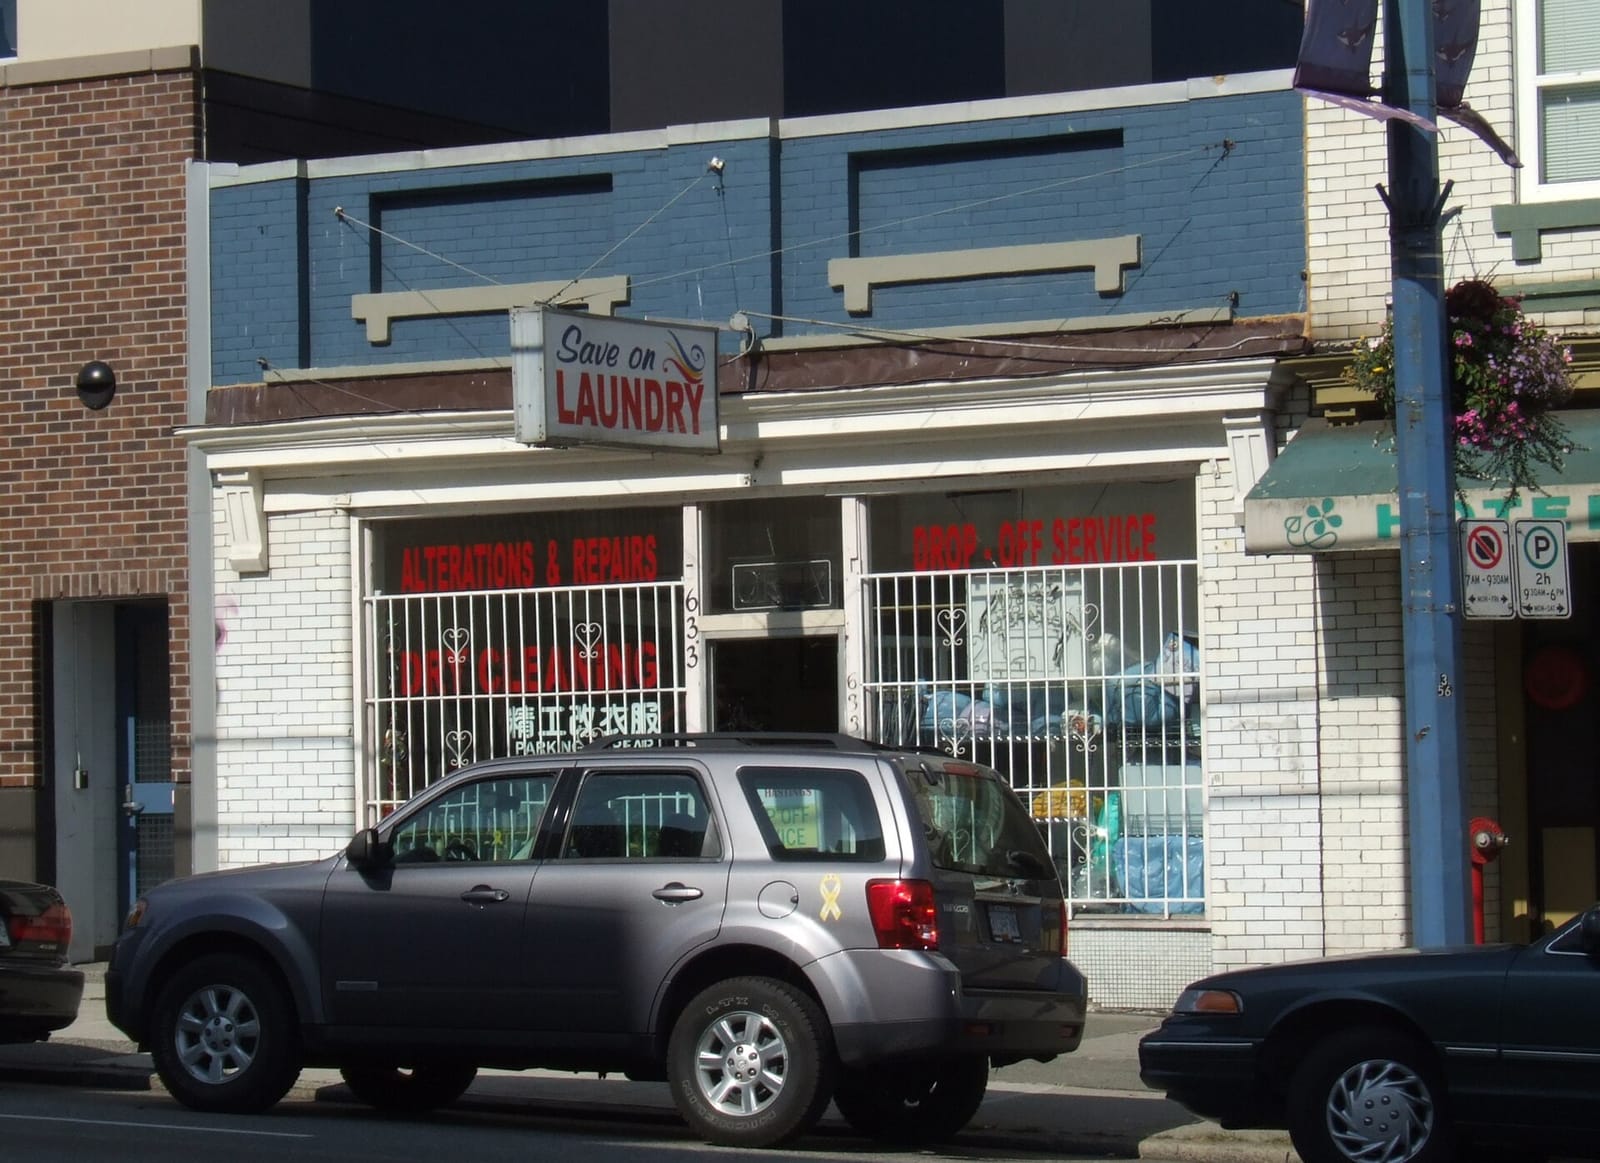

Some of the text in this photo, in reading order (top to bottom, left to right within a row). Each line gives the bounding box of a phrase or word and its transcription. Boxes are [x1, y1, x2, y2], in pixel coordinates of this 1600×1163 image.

[556, 325, 656, 370] Save on
[556, 369, 704, 435] LAUNDRY
[401, 534, 658, 592] ALTERATIONS & REPAIRS
[912, 523, 977, 571] DROP
[998, 520, 1043, 566] OFF
[1052, 513, 1157, 563] SERVICE
[1534, 535, 1550, 559] P
[1535, 572, 1551, 585] 2h
[685, 588, 698, 669] 633
[401, 641, 658, 696] DRY CLEANING
